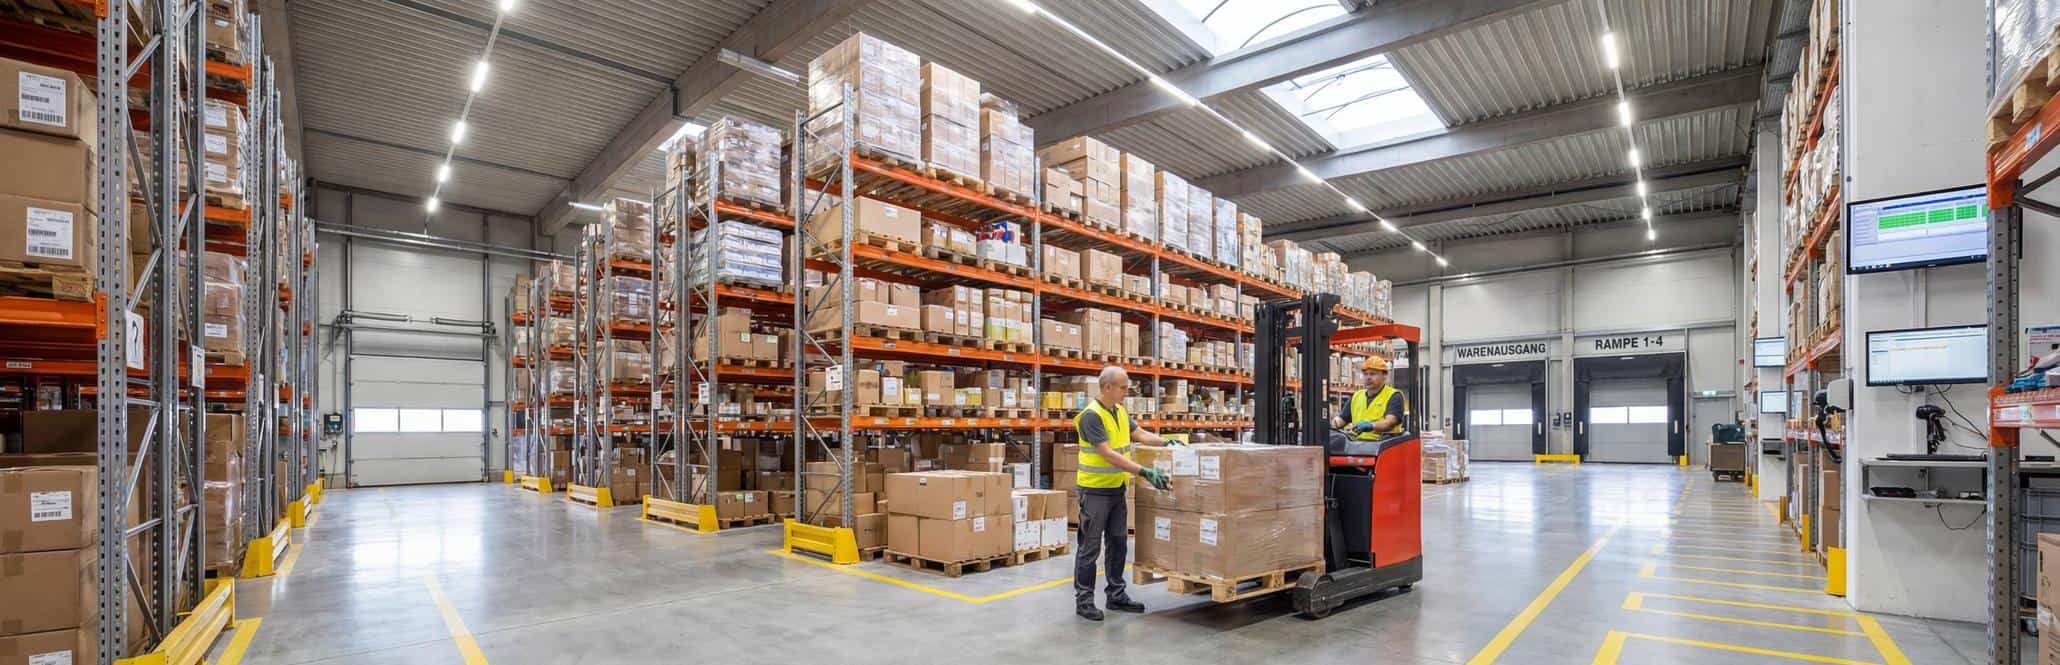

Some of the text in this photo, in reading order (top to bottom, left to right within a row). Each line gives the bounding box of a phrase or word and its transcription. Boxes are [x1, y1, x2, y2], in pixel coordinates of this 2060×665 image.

[1595, 335, 1663, 350] RAMPE 1-4
[1457, 343, 1546, 358] WARENAUSGANG
